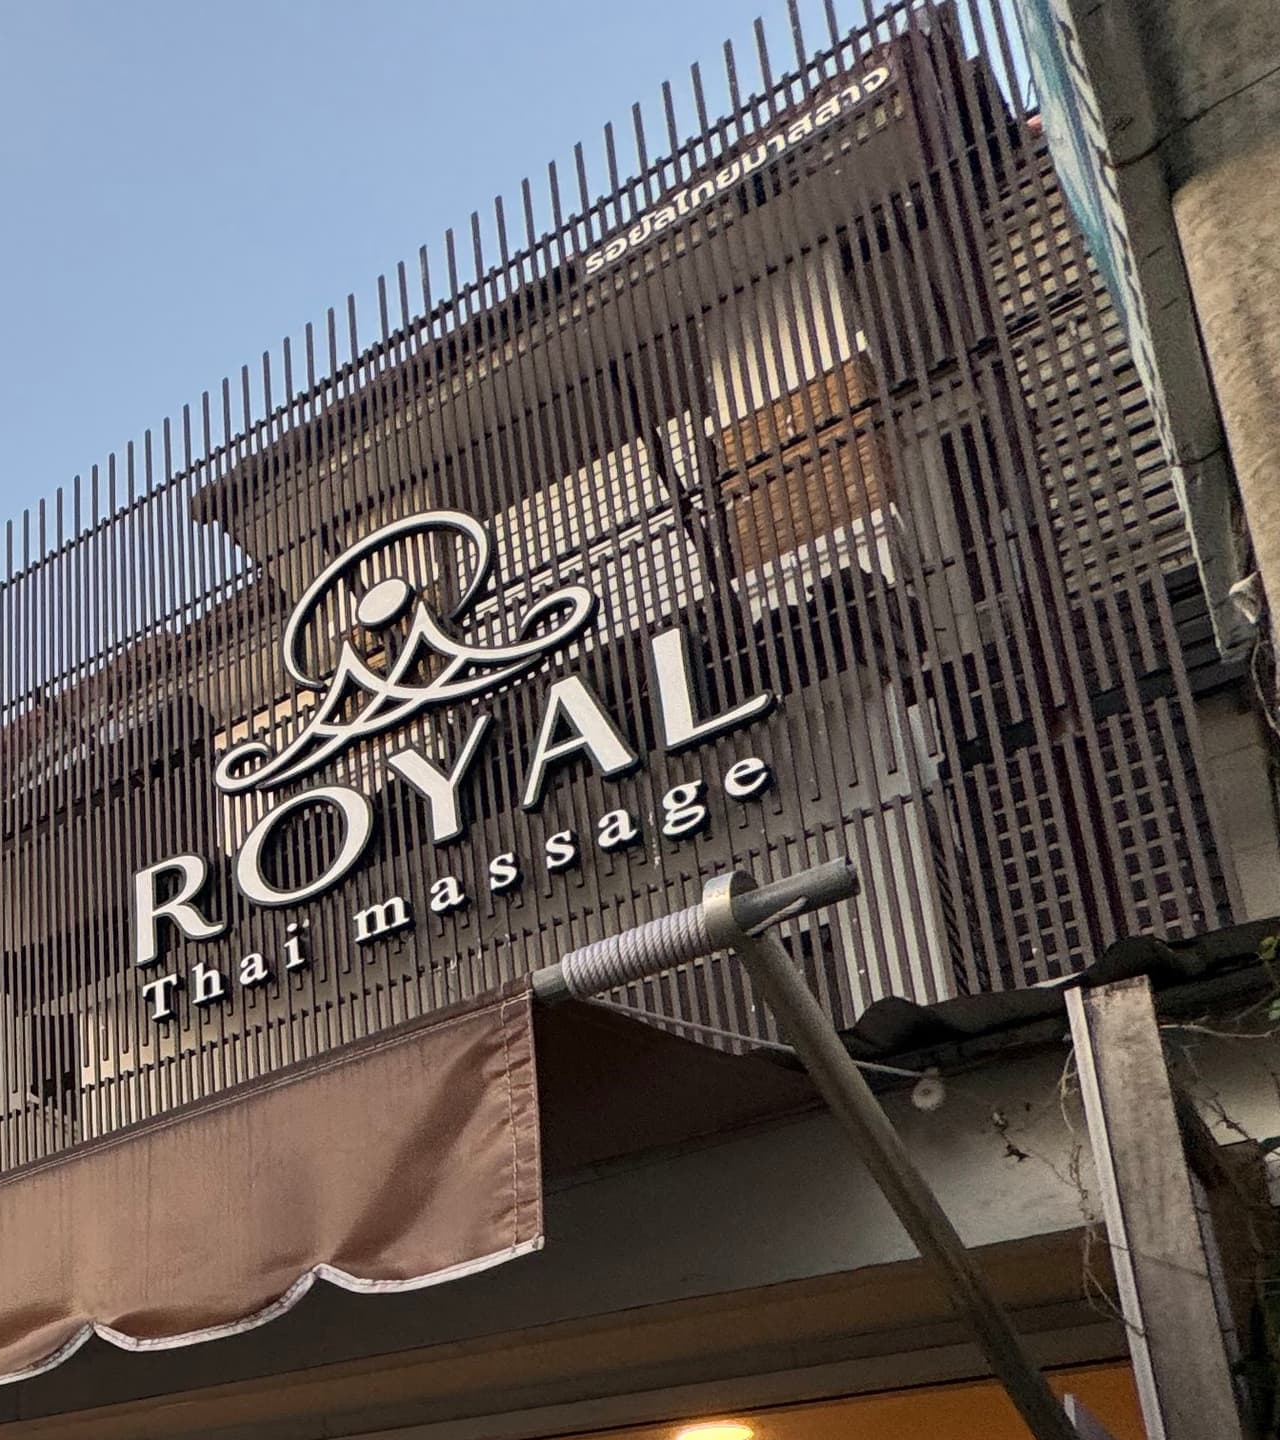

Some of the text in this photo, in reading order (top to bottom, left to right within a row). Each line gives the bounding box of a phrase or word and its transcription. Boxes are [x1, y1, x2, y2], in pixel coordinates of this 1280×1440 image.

[134, 627, 775, 967] ROYAL
[143, 756, 773, 1022] Thai massage
